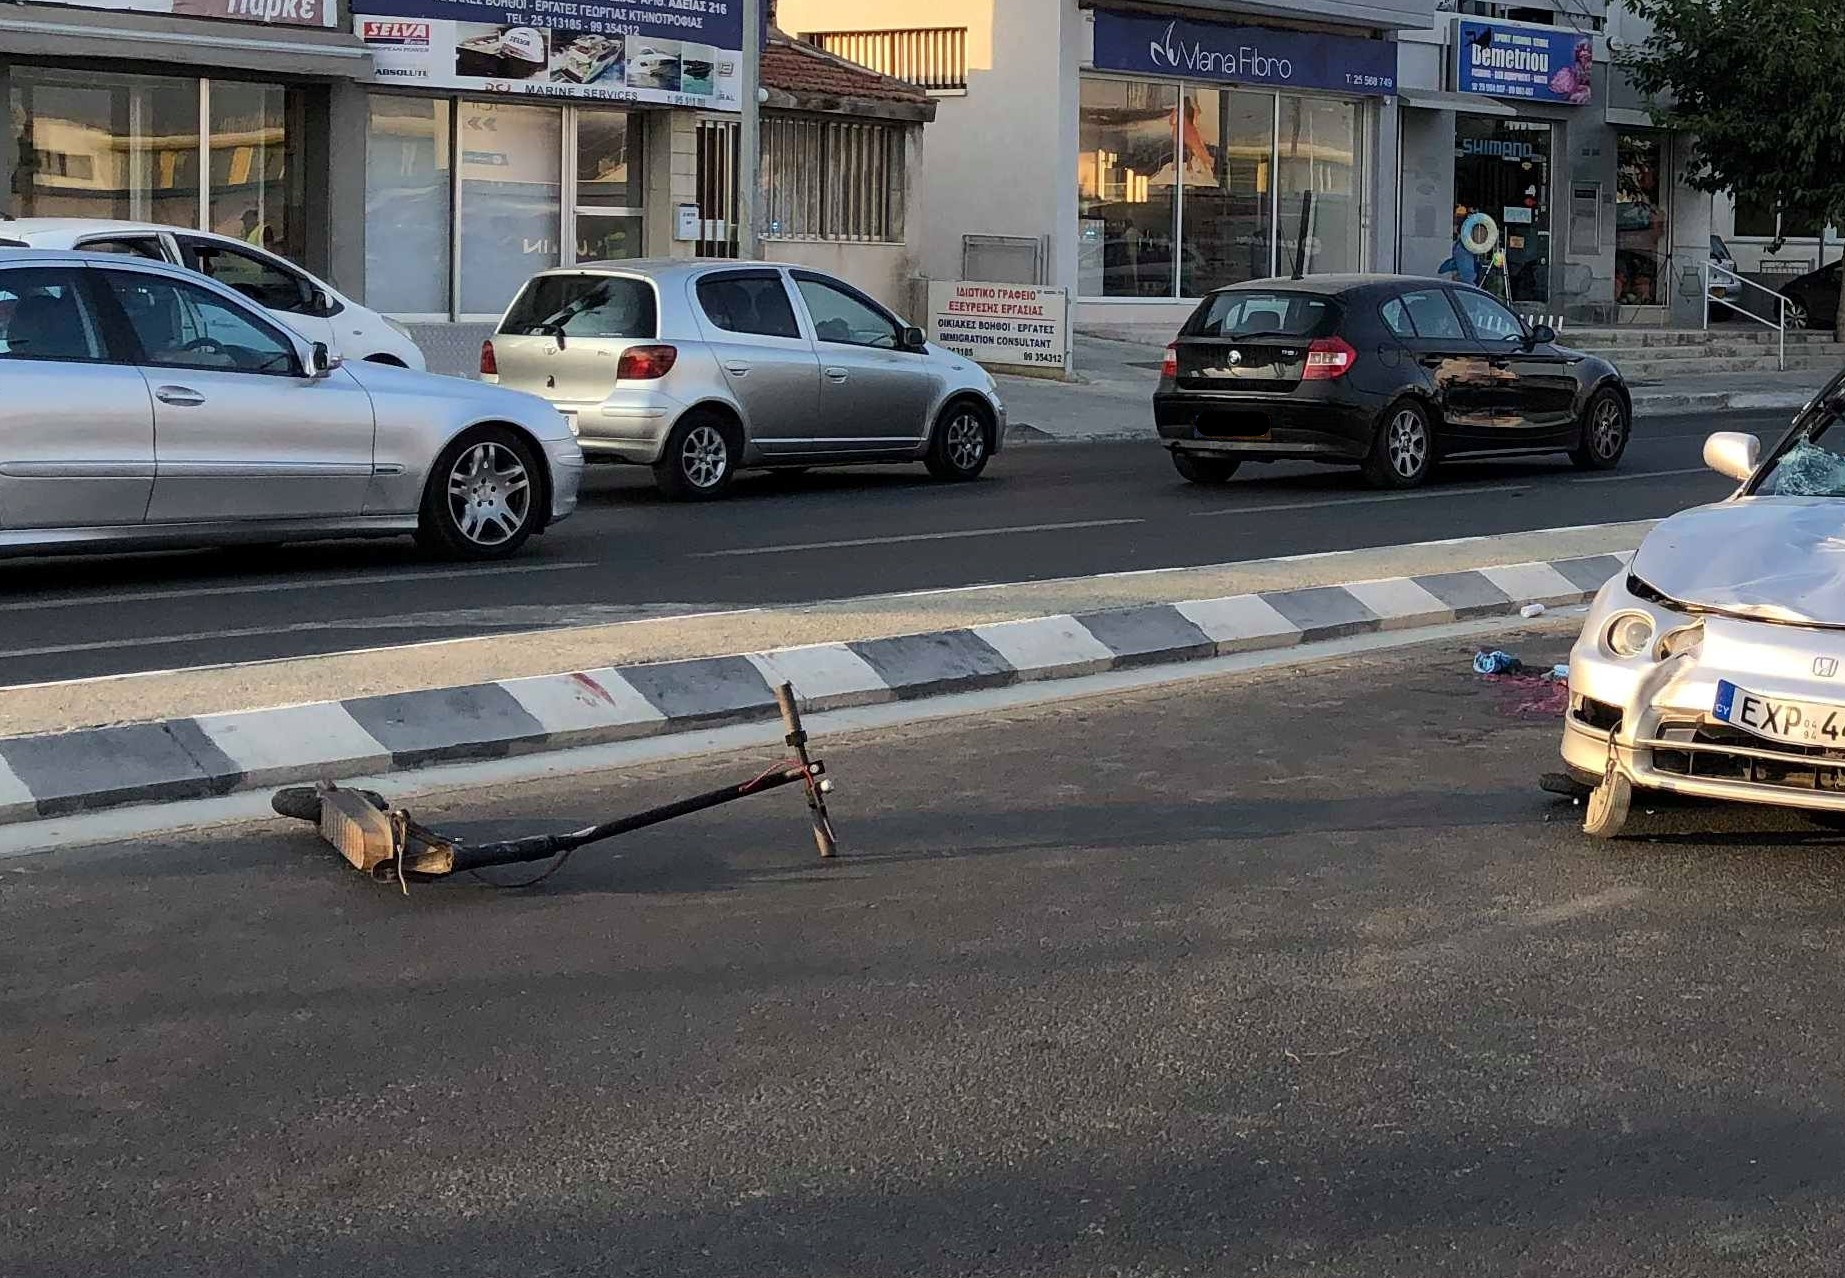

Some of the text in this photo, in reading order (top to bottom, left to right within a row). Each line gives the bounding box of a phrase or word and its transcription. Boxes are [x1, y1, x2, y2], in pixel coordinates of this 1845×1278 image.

[535, 4, 578, 16] ΕΡΓΑΤΕΣ
[580, 4, 627, 20] ΓΕΩΡΓΙΑΣ
[708, 3, 727, 15] 216
[368, 23, 427, 37] SELVA
[531, 15, 543, 26] 25
[604, 23, 640, 36] 354312
[1240, 46, 1292, 79] Fibro
[1471, 43, 1548, 73] Demetriou
[525, 84, 575, 97] MARINE
[583, 88, 638, 100] SERVICES
[1462, 138, 1533, 158] SHIMANO
[998, 288, 1036, 301] ΓΡΑΦΕΙΟ
[948, 300, 1043, 316] ΕΞΕΥΡΕΣΗΣ ΕΡΓΑΣΙΑΣ
[938, 318, 976, 330] ΟΙΚΙΑΚΕΣ
[978, 321, 1011, 332] ΒΟΗΘΟΙ
[1017, 323, 1054, 334] ΕΡΓΑΤΕΣ
[940, 332, 1051, 349] IMMIGRATION CONSULTANT
[1716, 703, 1730, 716] CY
[1741, 697, 1845, 740] EXP 4
